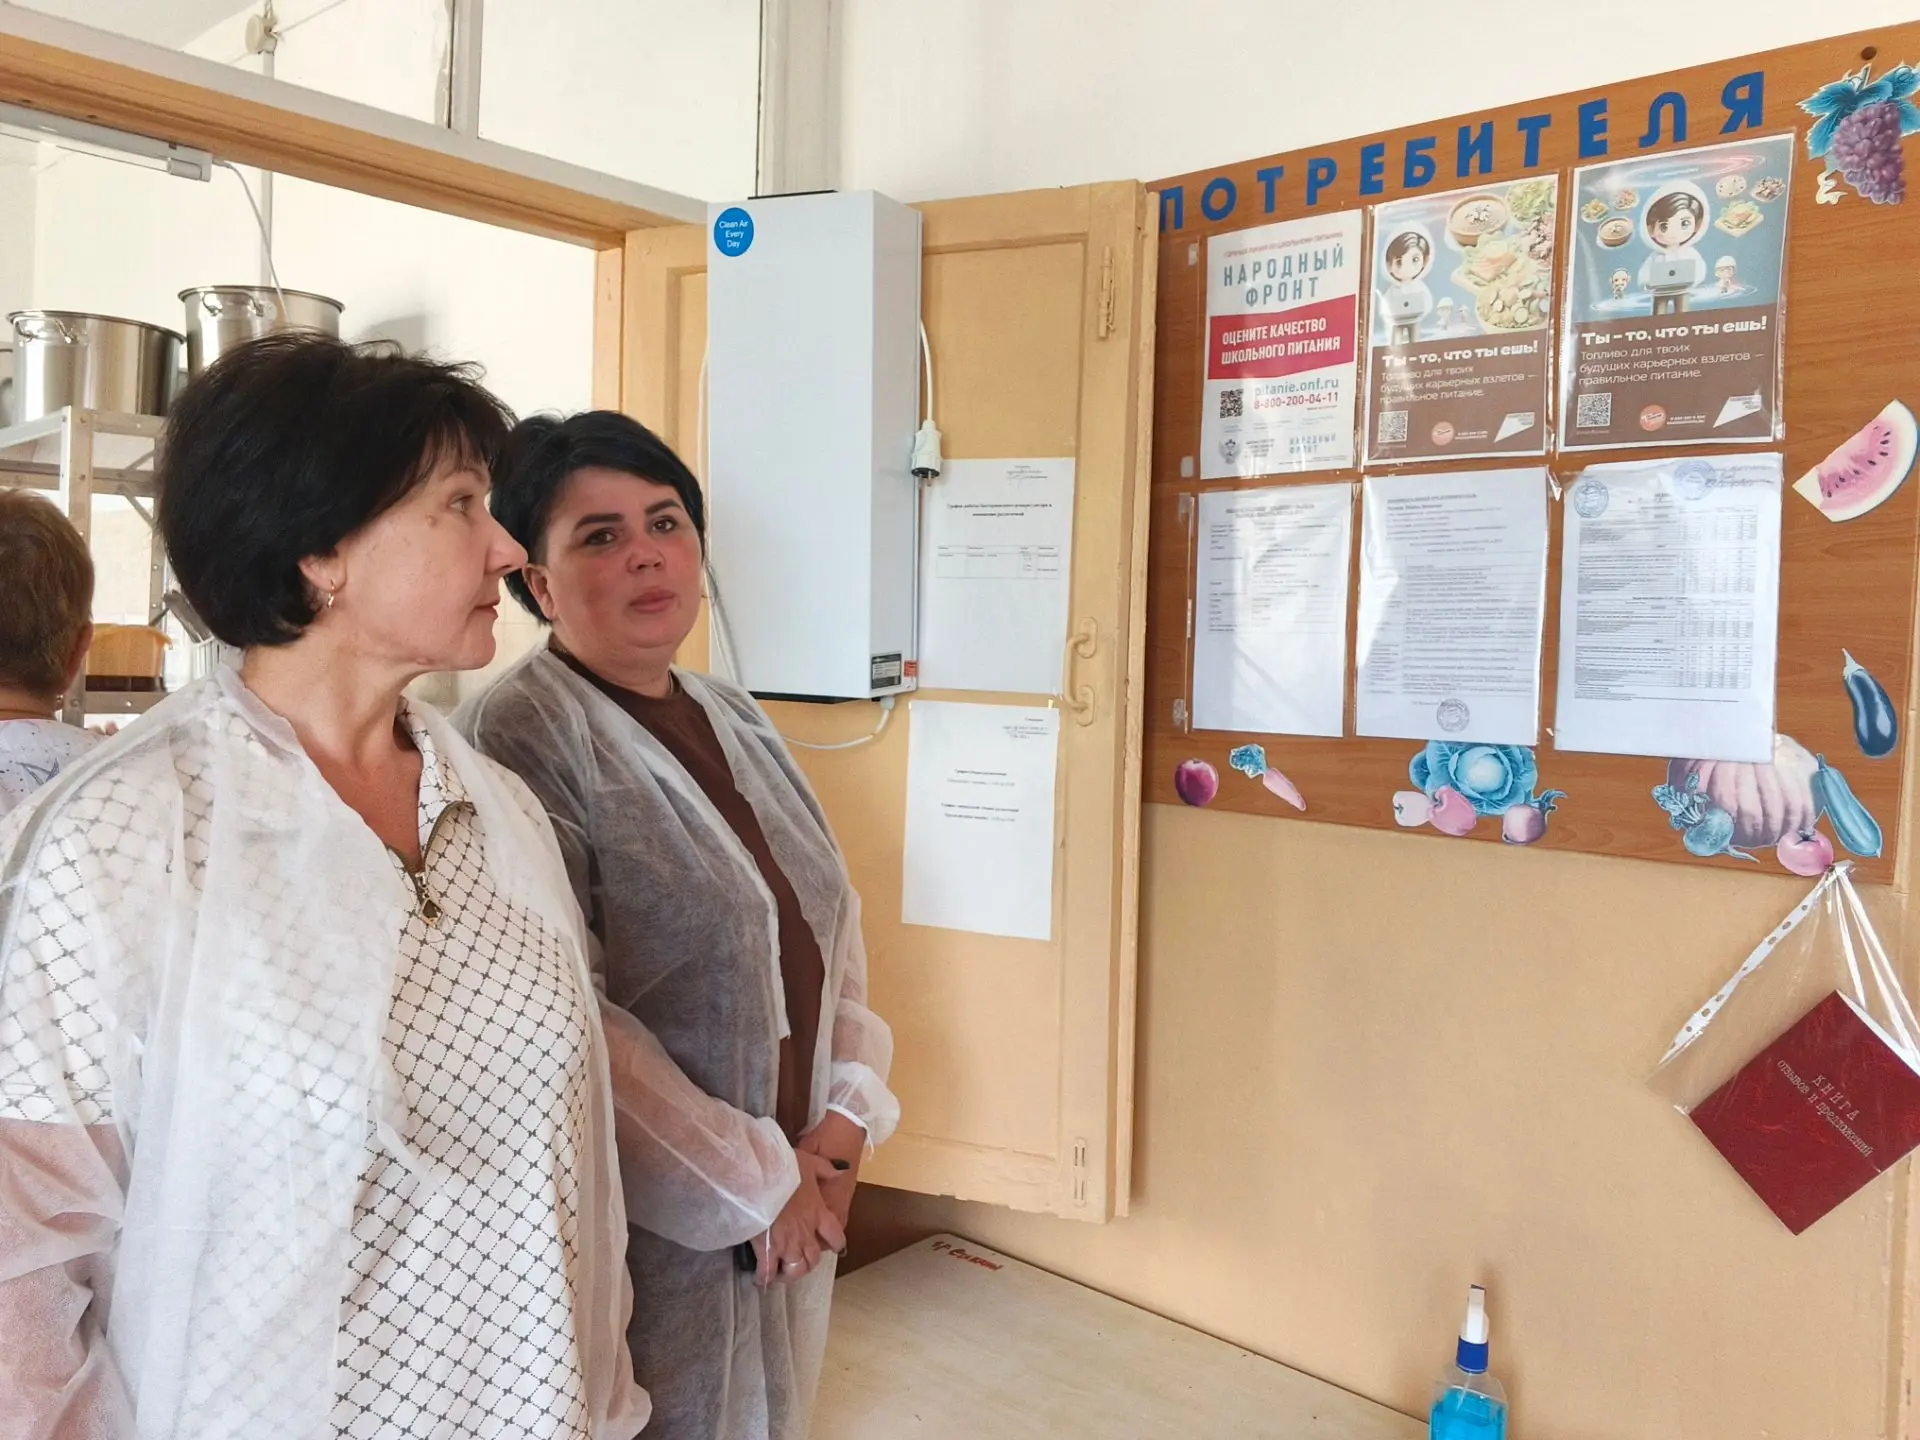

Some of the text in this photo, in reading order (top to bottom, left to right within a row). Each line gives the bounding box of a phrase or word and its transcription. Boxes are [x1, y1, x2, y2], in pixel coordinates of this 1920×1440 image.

[1160, 71, 1765, 232] ПОТРЕБИТЕЛЯ
[719, 221, 738, 229] Clean
[725, 230, 744, 239] Every
[726, 240, 740, 248] Day
[1224, 243, 1344, 286] НАРОДНЫЙ
[1246, 277, 1319, 307] ФРОНТ
[1222, 317, 1327, 346] ОЦЕНИТЕ КАЧЕСТВО
[1581, 332, 1610, 346] Ты
[1625, 330, 1652, 342] то,
[1655, 326, 1689, 339] что
[1691, 323, 1719, 336] ты
[1722, 315, 1767, 332] ешь!
[1221, 336, 1341, 365] ШКОЛЬНОГО ПИТАНИЯ
[1381, 354, 1406, 367] Ты
[1419, 353, 1441, 364] то,
[1444, 349, 1472, 361] что
[1475, 347, 1498, 358] ты
[1500, 340, 1538, 355] ешь!
[1581, 343, 1691, 361] Топливо для твоих
[1423, 368, 1442, 378] для
[1445, 365, 1474, 375] твоих
[1579, 361, 1630, 375] будущих
[1633, 355, 1698, 371] карьерных
[1701, 351, 1751, 364] взлетов
[1425, 376, 1480, 391] карьерных
[1482, 372, 1525, 384] взлетов
[1578, 372, 1648, 388] правильное
[1808, 1093, 1818, 1104] и
[1812, 1074, 1860, 1121] КНИГА
